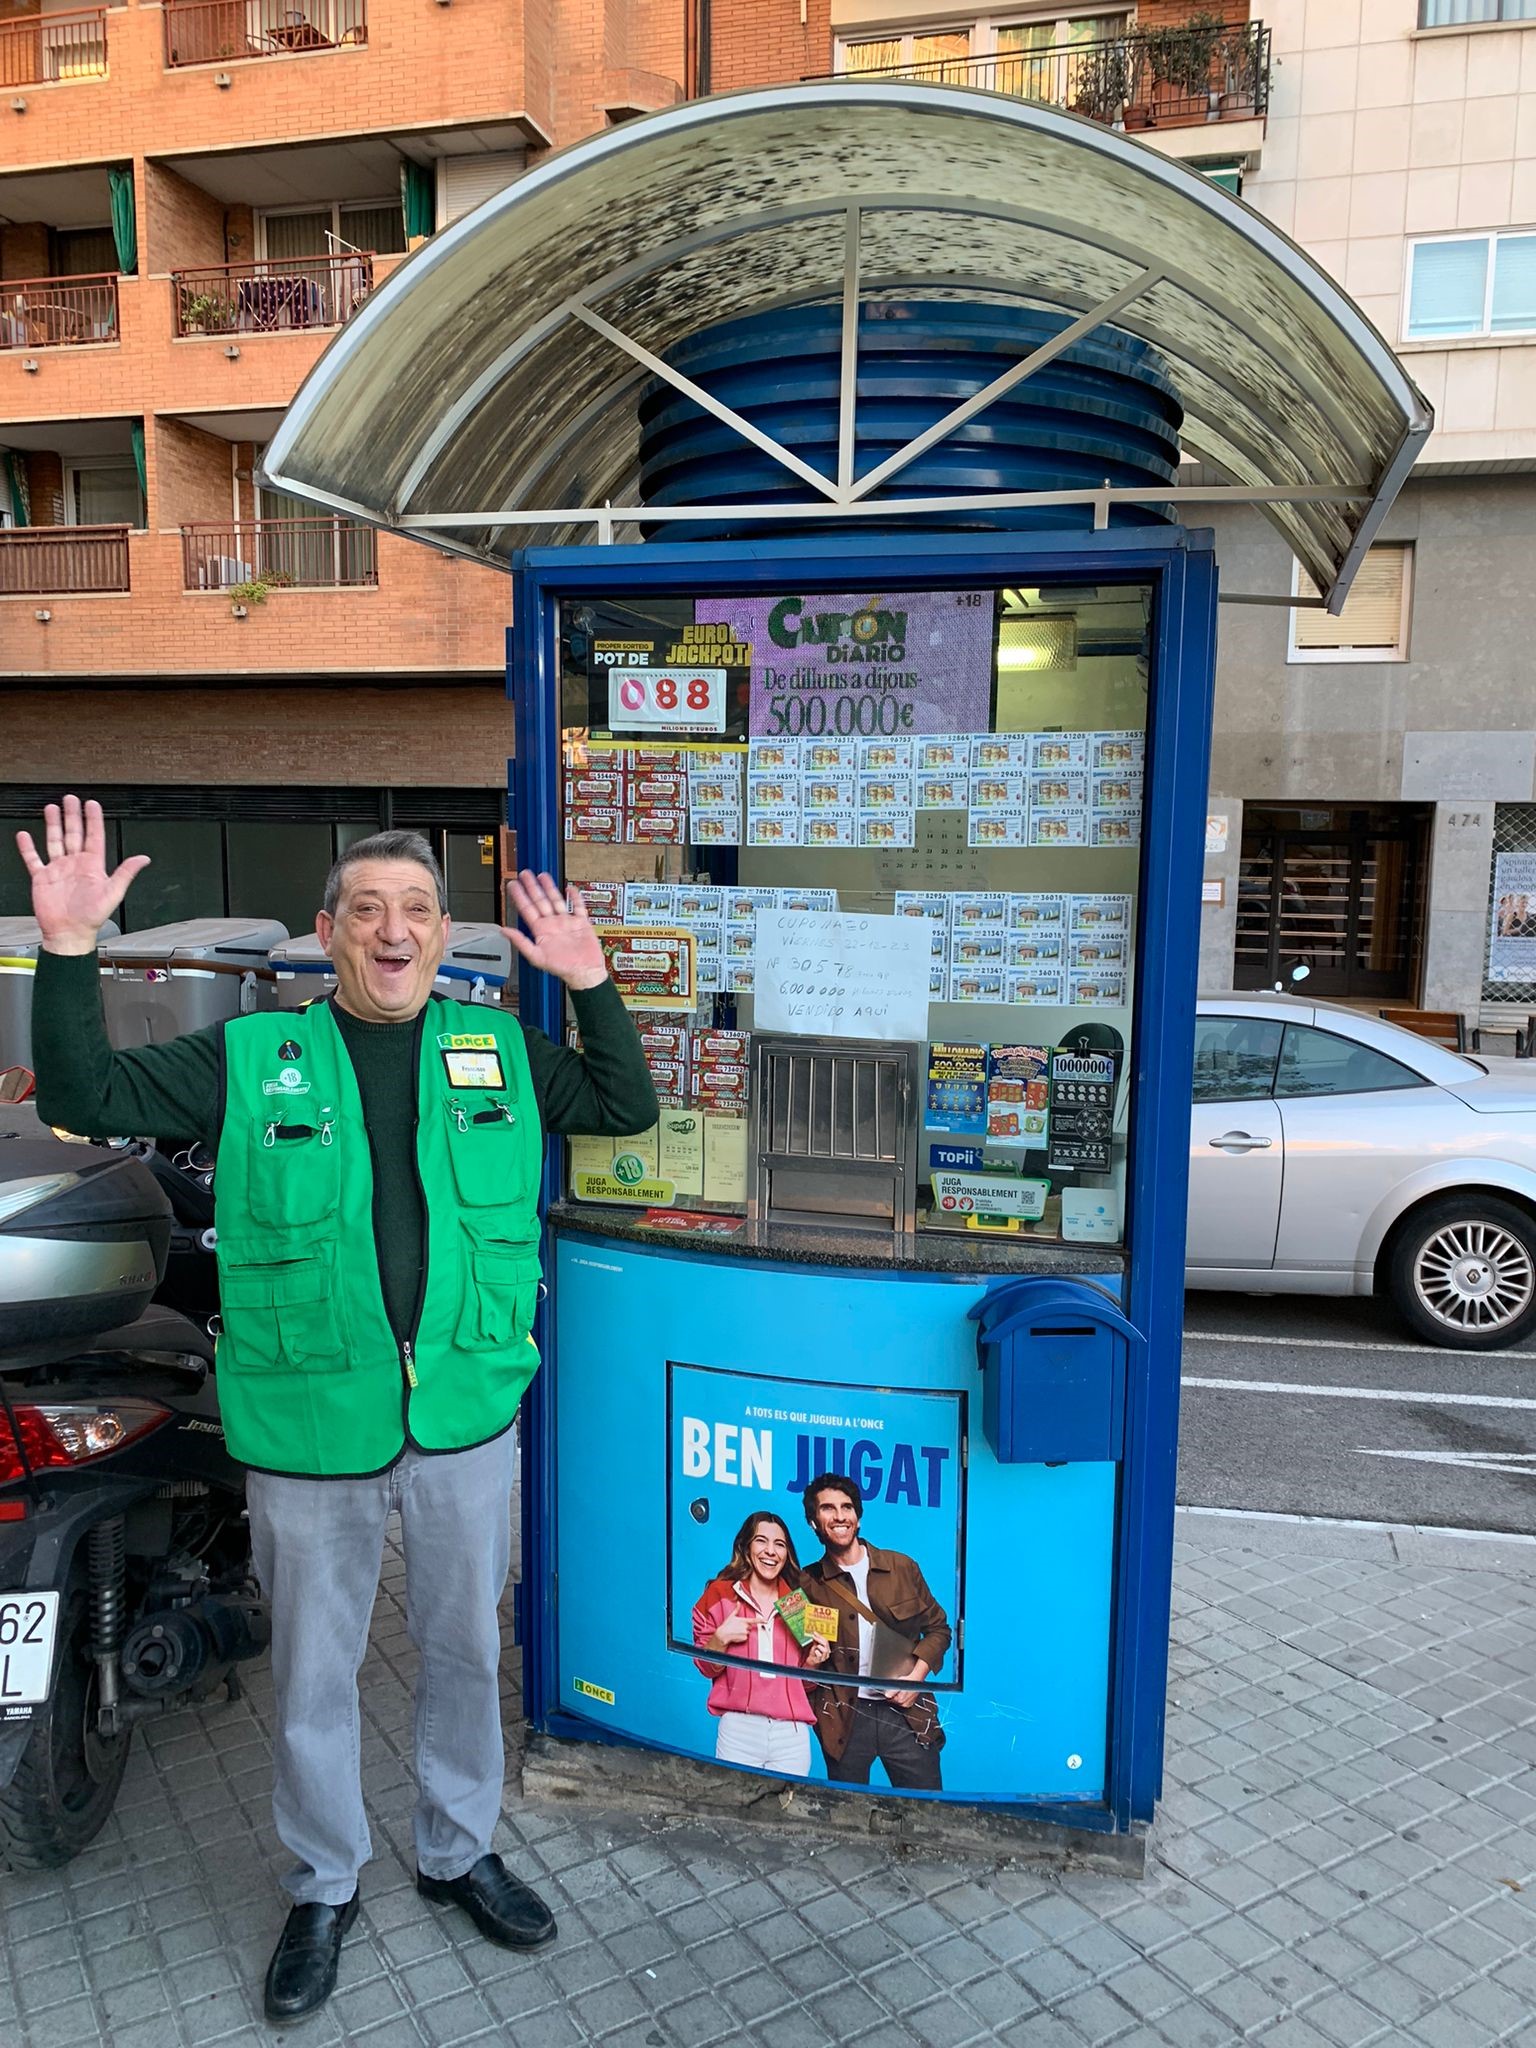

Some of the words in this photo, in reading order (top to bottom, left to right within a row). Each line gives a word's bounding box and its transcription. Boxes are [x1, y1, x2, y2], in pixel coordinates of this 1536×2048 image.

[955, 595, 981, 607] +18
[683, 625, 728, 644] EURO
[596, 642, 621, 650] PROPER
[594, 652, 626, 665] POT
[628, 652, 649, 666] DE
[665, 644, 746, 665] JACKPOT
[764, 668, 786, 690] De
[789, 668, 848, 690] dilluns
[851, 674, 862, 690] a
[767, 695, 914, 736] 500.000€
[1448, 814, 1482, 828] 474
[454, 1037, 492, 1046] ONCE
[617, 1158, 642, 1180] +18
[586, 1177, 606, 1186] JUGA
[941, 1177, 962, 1186] JUGA
[586, 1186, 664, 1198] RESPONSABLEMENT
[941, 1186, 1018, 1198] RESPONSABLEMENT
[745, 1406, 750, 1416] A
[752, 1406, 772, 1419] TOTS
[774, 1410, 788, 1420] ELS
[790, 1412, 807, 1423] QUE
[809, 1413, 842, 1426] JUGUEU
[844, 1418, 851, 1428] A
[852, 1418, 884, 1430] L'ONCE
[683, 1416, 773, 1491] BEN
[786, 1434, 949, 1508] JUGAT
[0, 1600, 46, 1645] 62
[1, 1654, 22, 1698] L
[586, 1684, 612, 1702] ONCE
[6, 1706, 32, 1716] YAMAHA
